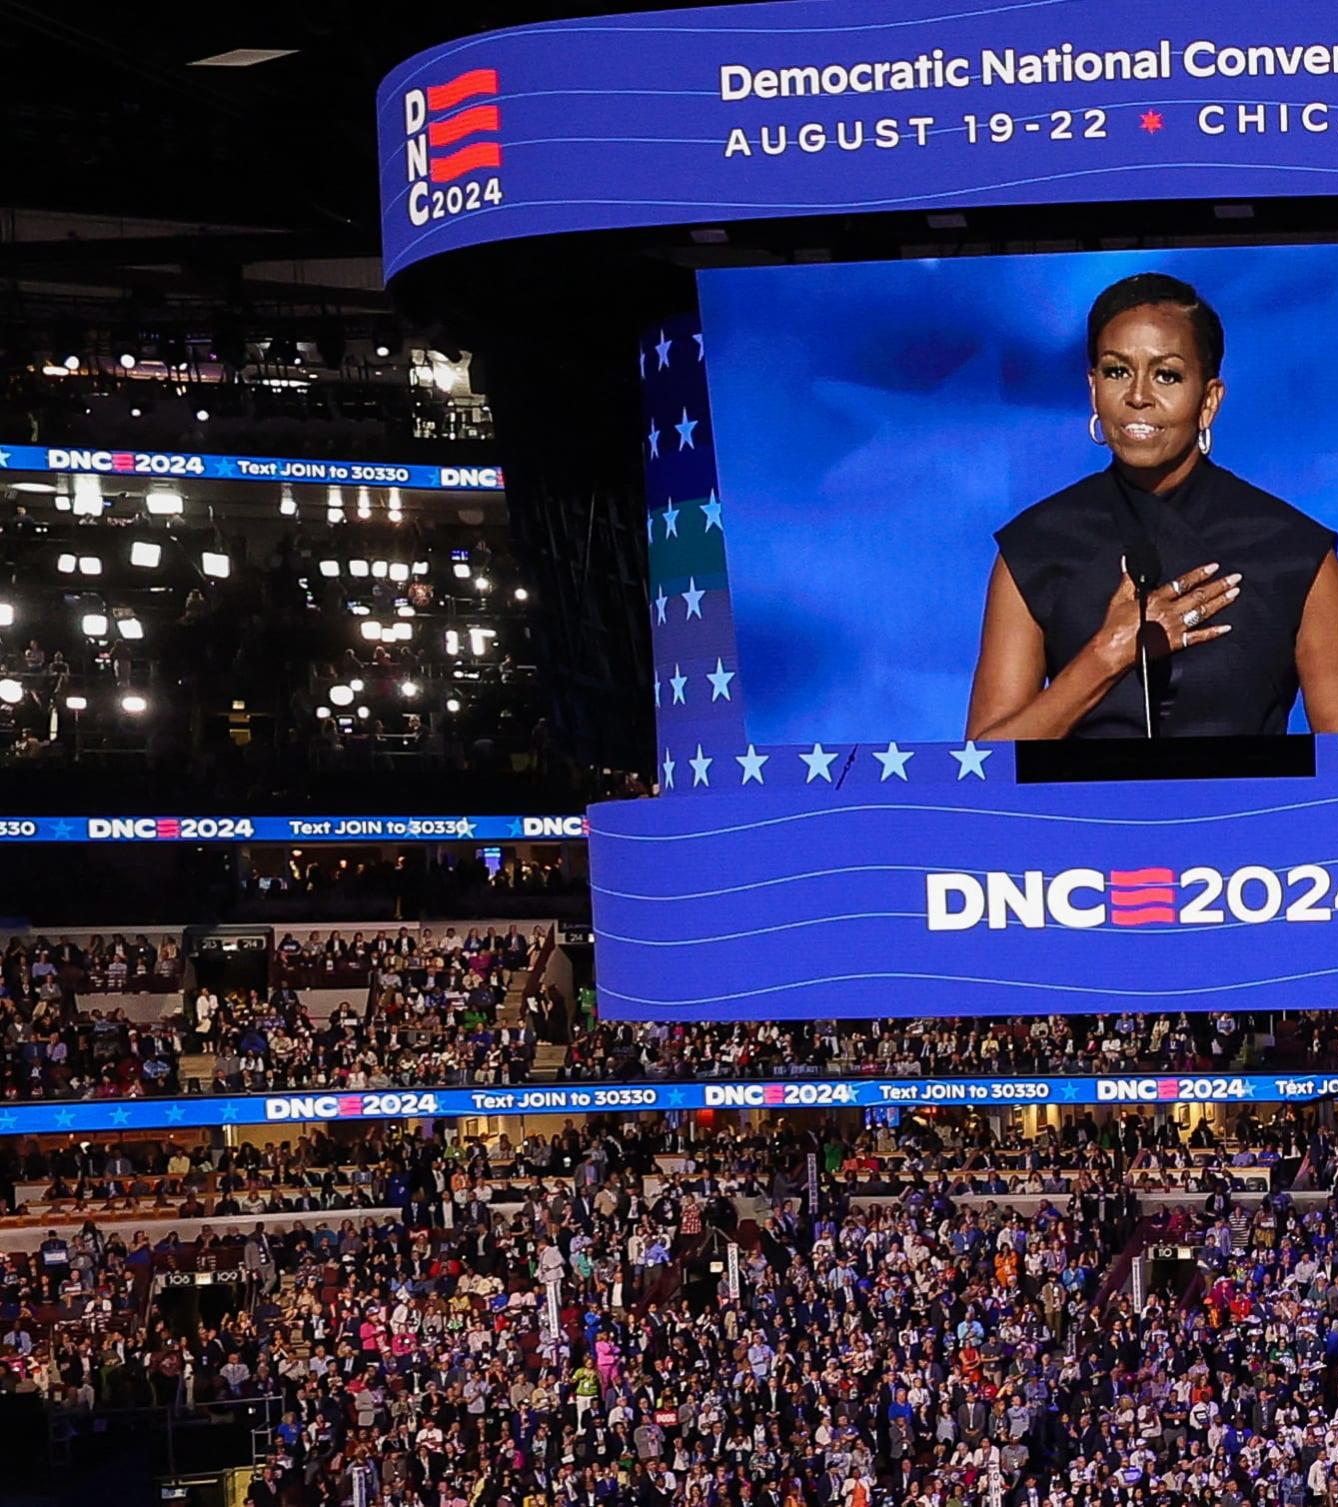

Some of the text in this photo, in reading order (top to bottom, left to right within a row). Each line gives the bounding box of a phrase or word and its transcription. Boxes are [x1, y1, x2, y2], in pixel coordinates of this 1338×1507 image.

[720, 49, 969, 100] Democratic
[982, 40, 1170, 85] National
[725, 117, 934, 157] AUGUST
[964, 109, 1107, 143] 19-22
[432, 178, 502, 219] 2024
[49, 449, 204, 474] DNC 2024
[237, 461, 409, 481] Text JOIN to 30330
[441, 468, 497, 486] DNC
[88, 819, 254, 837] DNC 2024
[290, 821, 467, 834] Text JOIN to 30330
[523, 817, 582, 836] DNC
[925, 868, 1105, 931] DNC
[704, 1084, 850, 1106] DNC 2024
[880, 1082, 1049, 1099] Text JOIN to 30330
[1097, 1079, 1245, 1099] DNC 2024
[1275, 1079, 1313, 1094] Text
[266, 1093, 437, 1120] DNC 2024
[472, 1089, 656, 1109] Text JOIN to 30330
